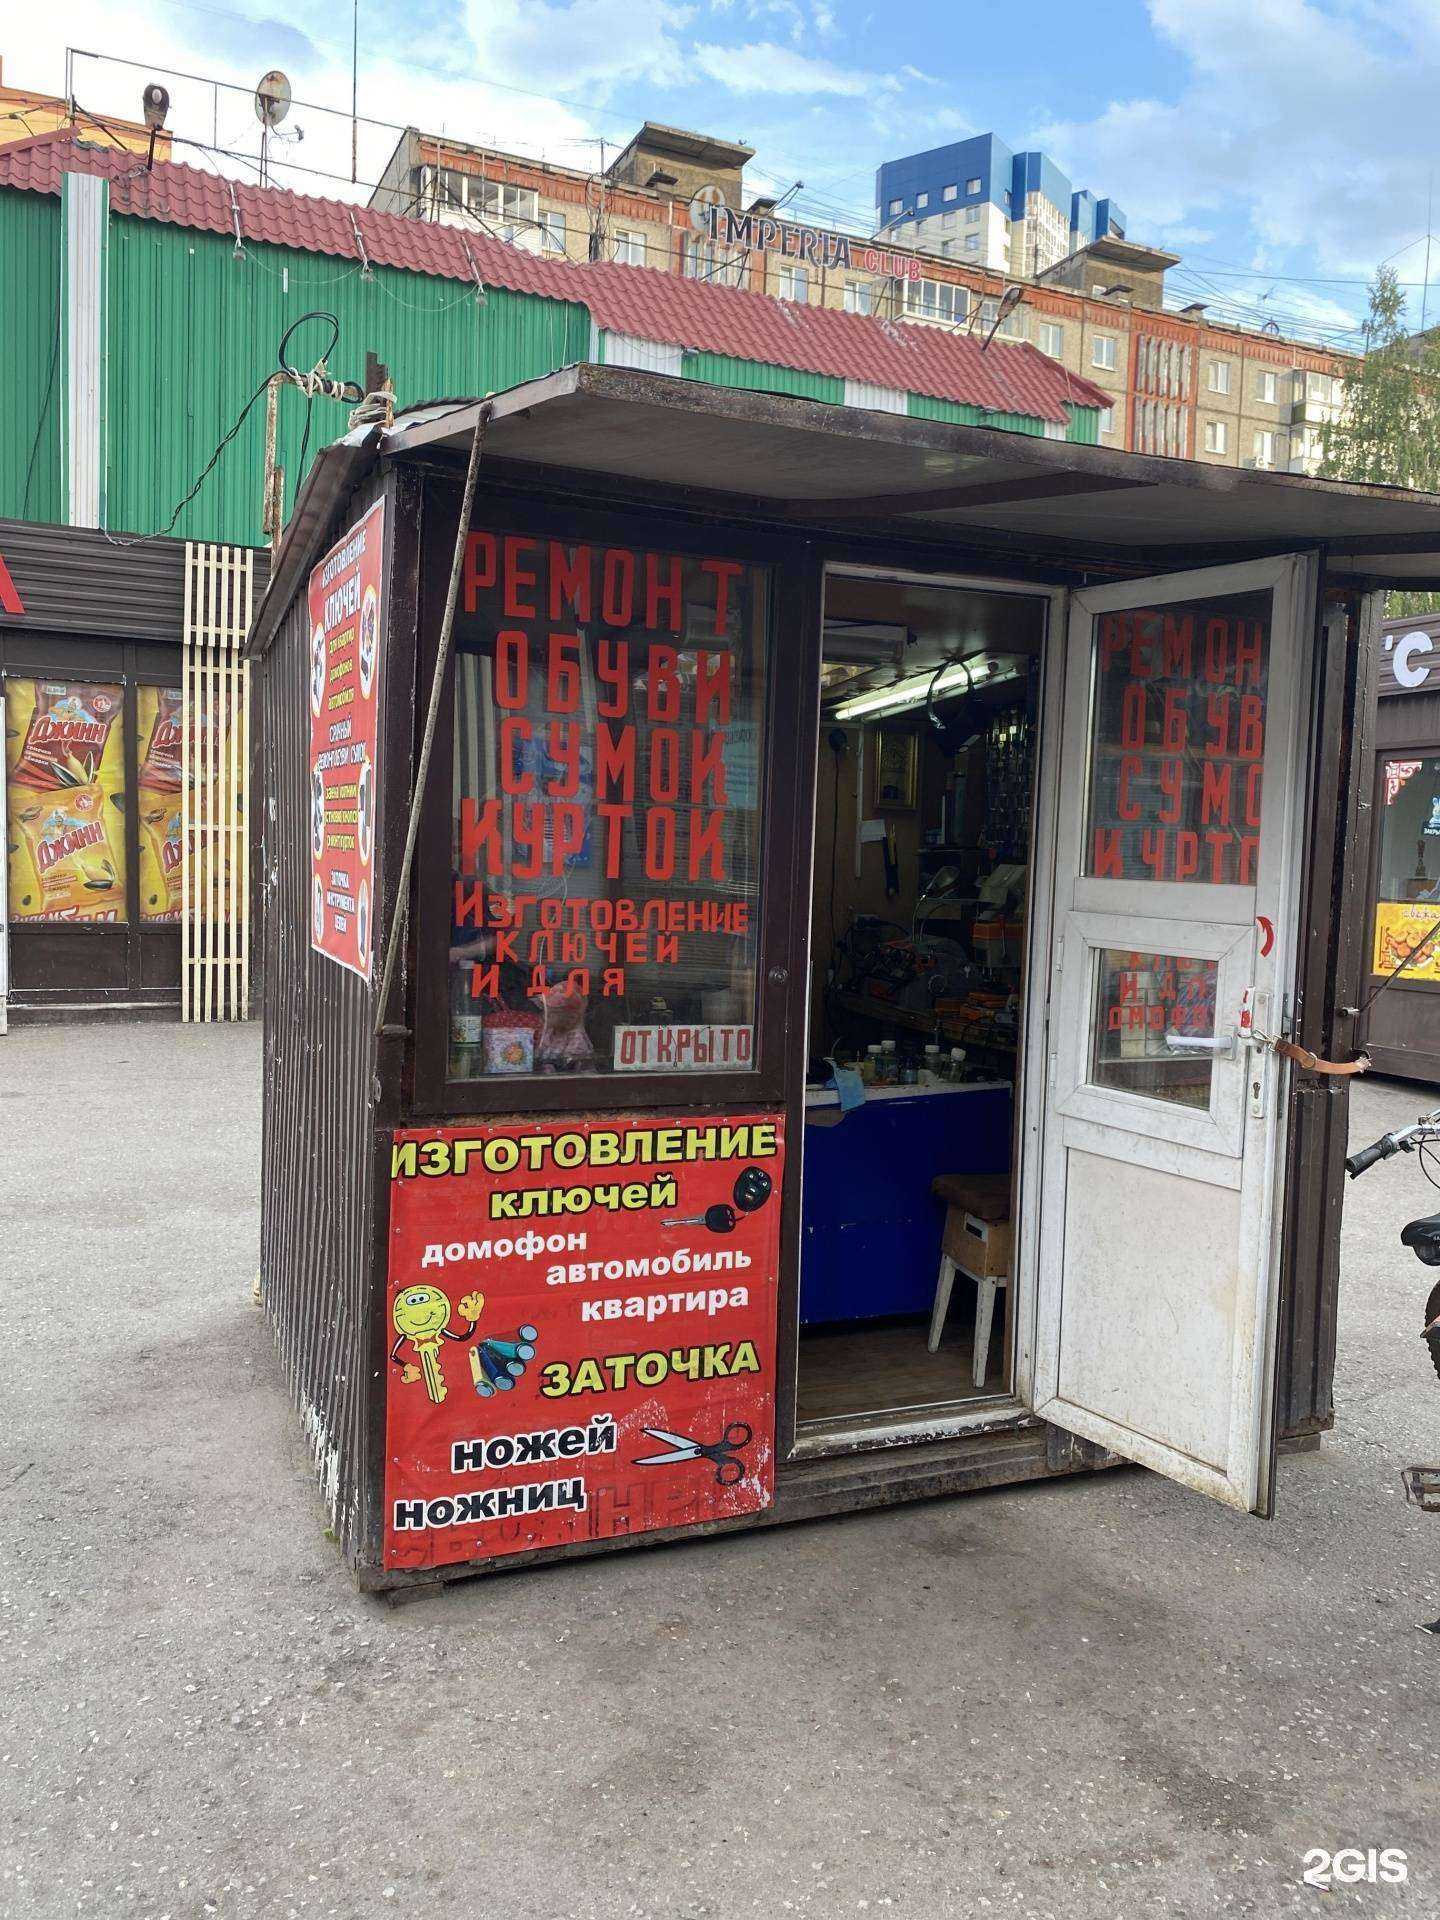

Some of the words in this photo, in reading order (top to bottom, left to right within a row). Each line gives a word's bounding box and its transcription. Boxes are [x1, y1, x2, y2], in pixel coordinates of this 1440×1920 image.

[709, 205, 851, 270] IMPERIA
[865, 249, 921, 282] CLUB
[324, 562, 361, 634] КЛЮЧЕЙ
[463, 530, 743, 636] РЕМОНТ
[495, 630, 731, 725] ОБУВИ
[499, 716, 728, 803] СУМОК
[455, 880, 750, 933] ИЗГОТОВЛЕНИЕ
[495, 929, 680, 964] КЛЮЧЕЙ
[471, 963, 500, 999] И
[527, 964, 626, 998] ДЛЯ
[620, 1028, 751, 1065] ОТКРЫТО
[391, 1124, 777, 1178] ИЗГОТОВЛЕНИЕ
[489, 1173, 678, 1219] ключей
[421, 1230, 588, 1268] домофон
[546, 1247, 752, 1286] автомобиль
[581, 1285, 750, 1323] квартира
[540, 1341, 762, 1399] ЗАТОЧКА
[451, 1414, 617, 1473] ножей
[394, 1478, 585, 1531] ножниц
